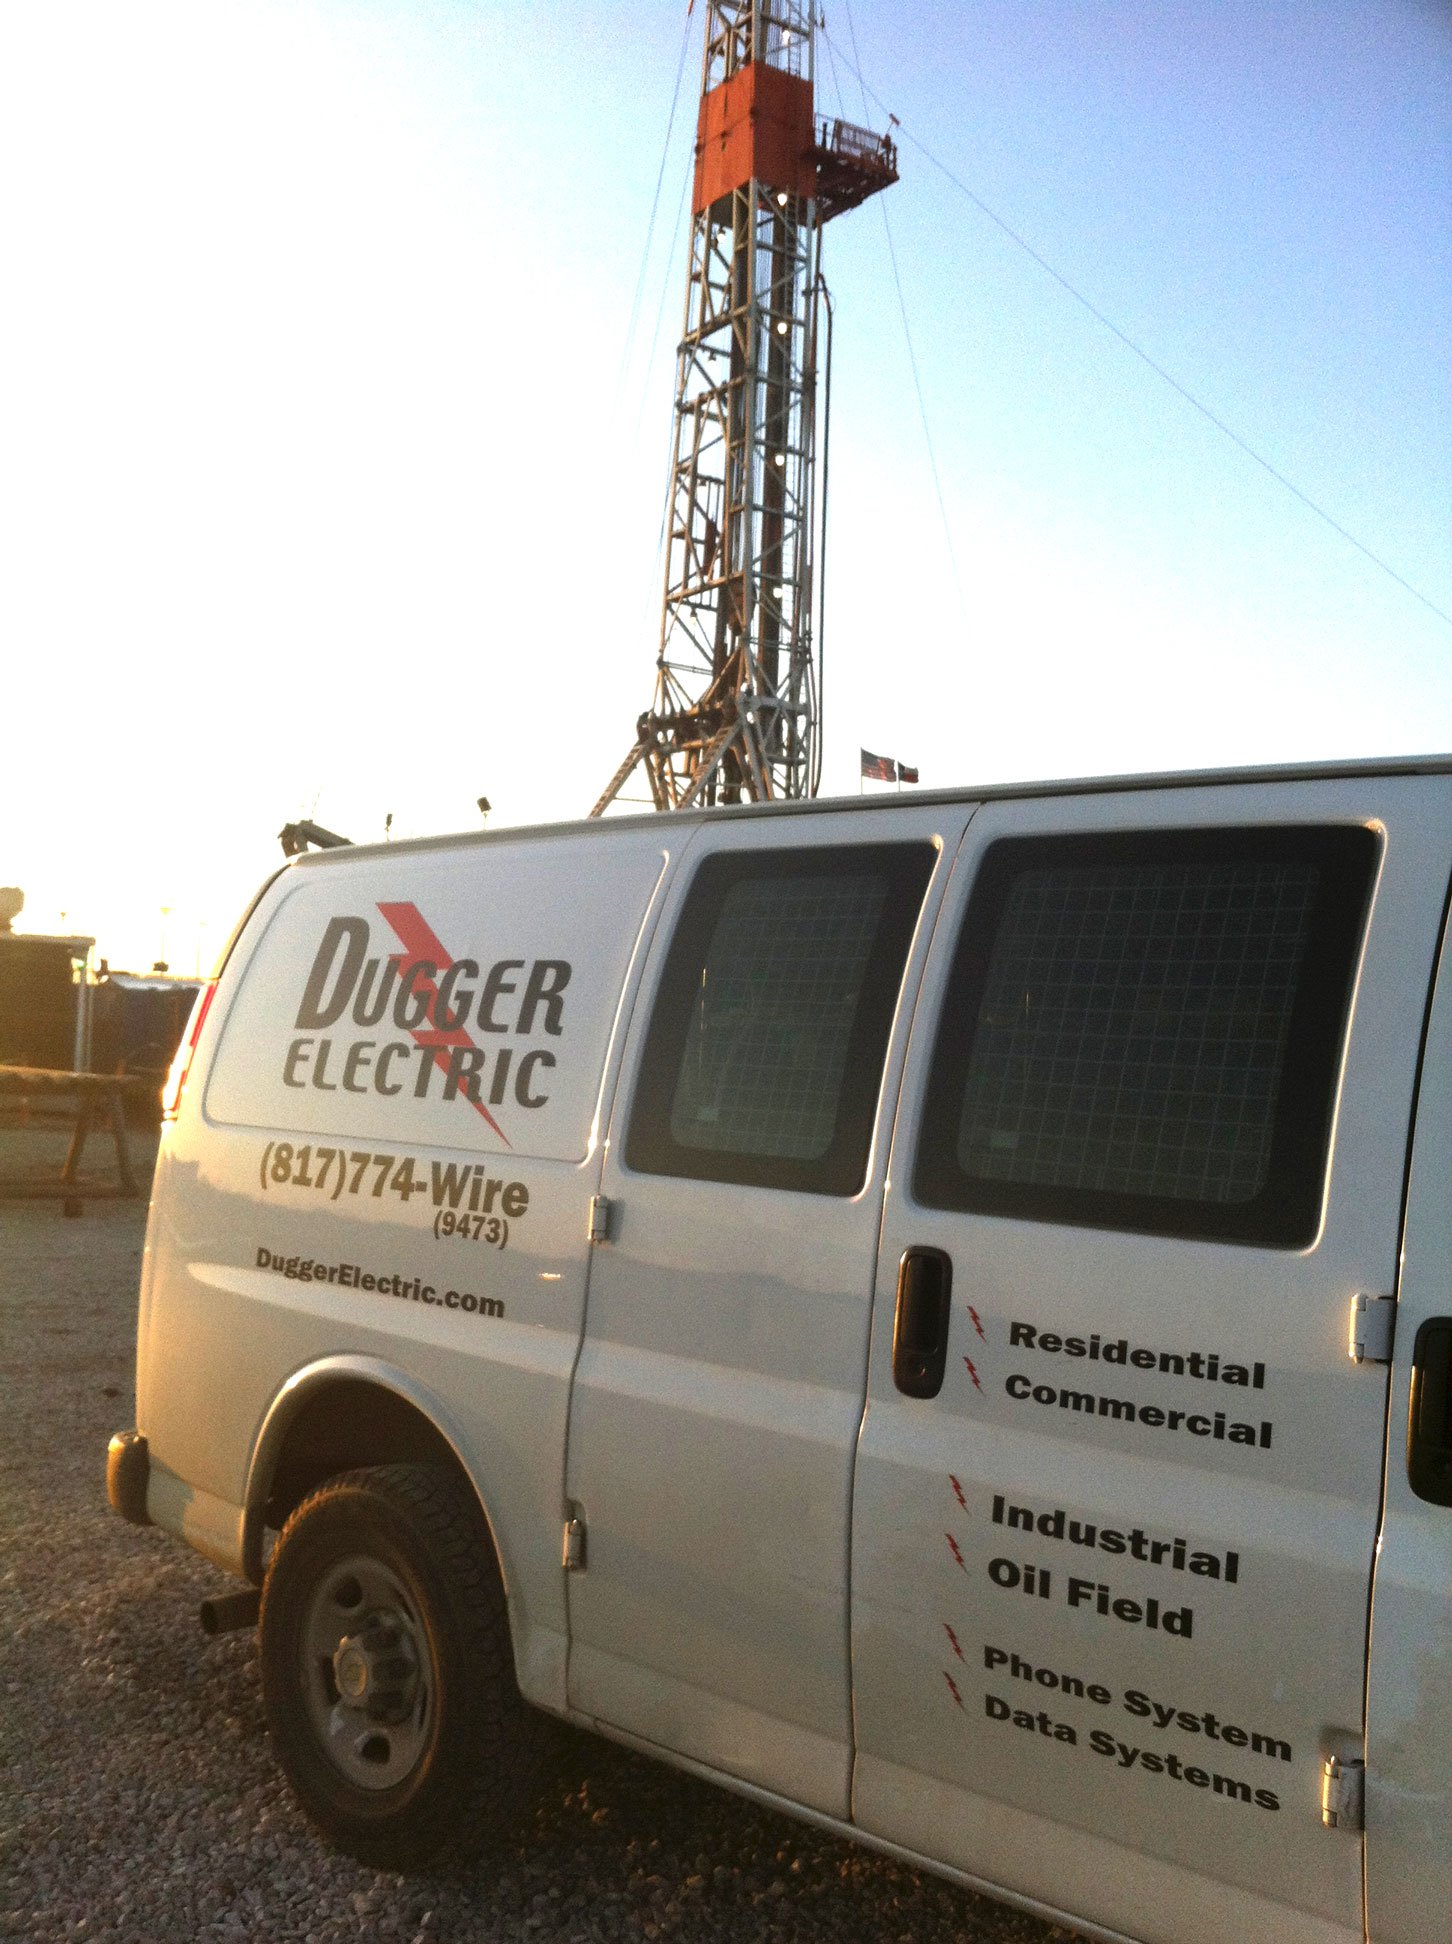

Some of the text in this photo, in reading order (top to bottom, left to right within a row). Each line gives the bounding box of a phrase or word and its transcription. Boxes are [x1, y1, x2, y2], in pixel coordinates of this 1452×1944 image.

[294, 916, 572, 1036] DUGGER
[283, 1038, 556, 1109] ELECTRIC
[260, 1142, 529, 1217] (817)774-Wire
[433, 1210, 509, 1250] (9473)
[256, 1247, 505, 1318] DuggerElectric.com
[1009, 1321, 1265, 1389] Residential
[1005, 1375, 1273, 1449] Commercial
[992, 1495, 1239, 1583] Industrial
[988, 1558, 1193, 1638] Oil Field
[984, 1645, 1292, 1762] Phone System
[985, 1694, 1280, 1812] Data Systems
